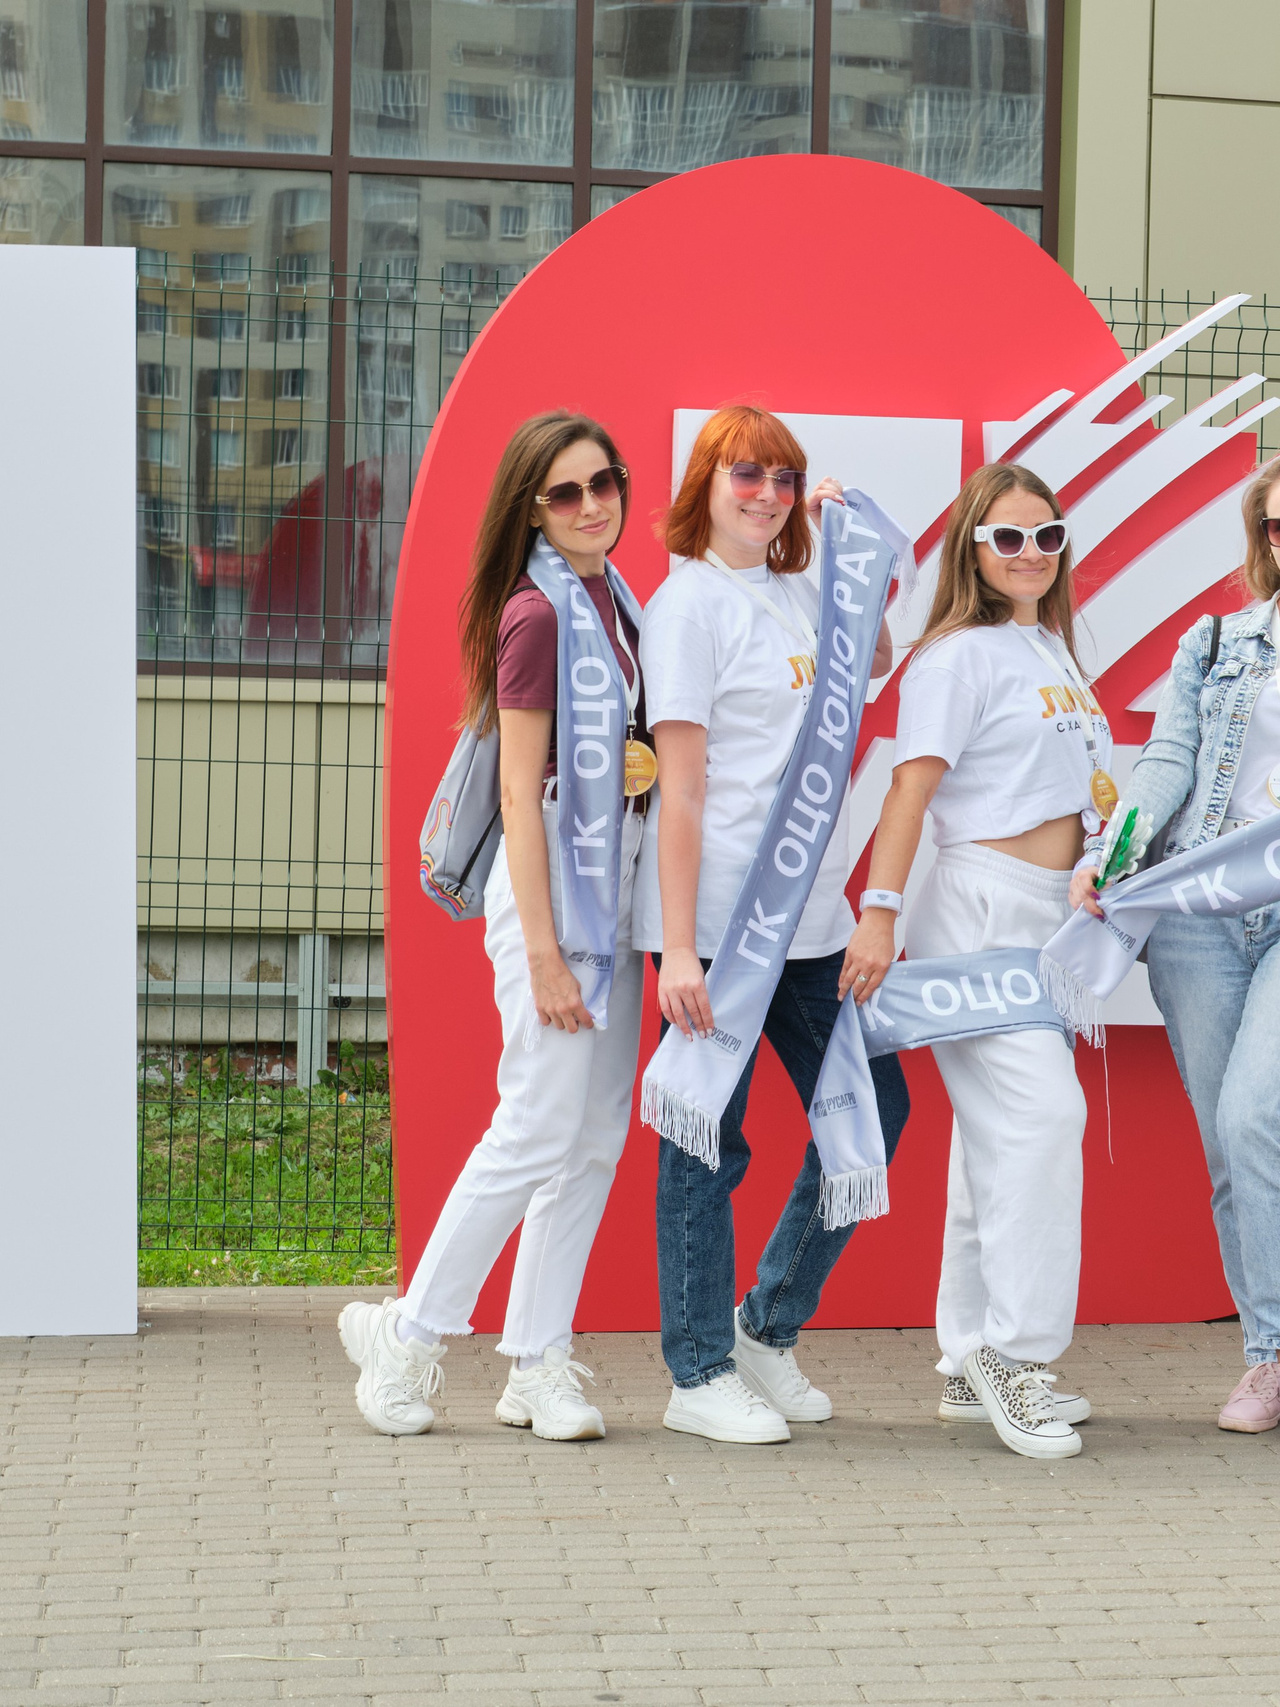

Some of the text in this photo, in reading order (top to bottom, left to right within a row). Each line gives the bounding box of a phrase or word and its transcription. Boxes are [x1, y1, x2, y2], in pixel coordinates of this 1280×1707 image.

[571, 656, 618, 877] ГК ОЦО
[736, 514, 881, 969] ГК ОЦО ЮЦО РАТ
[1171, 863, 1243, 915] ГК
[861, 967, 1041, 1032] К ОЦО
[711, 1026, 742, 1052] УСАГРО
[826, 1091, 857, 1111] РУСАГРО
